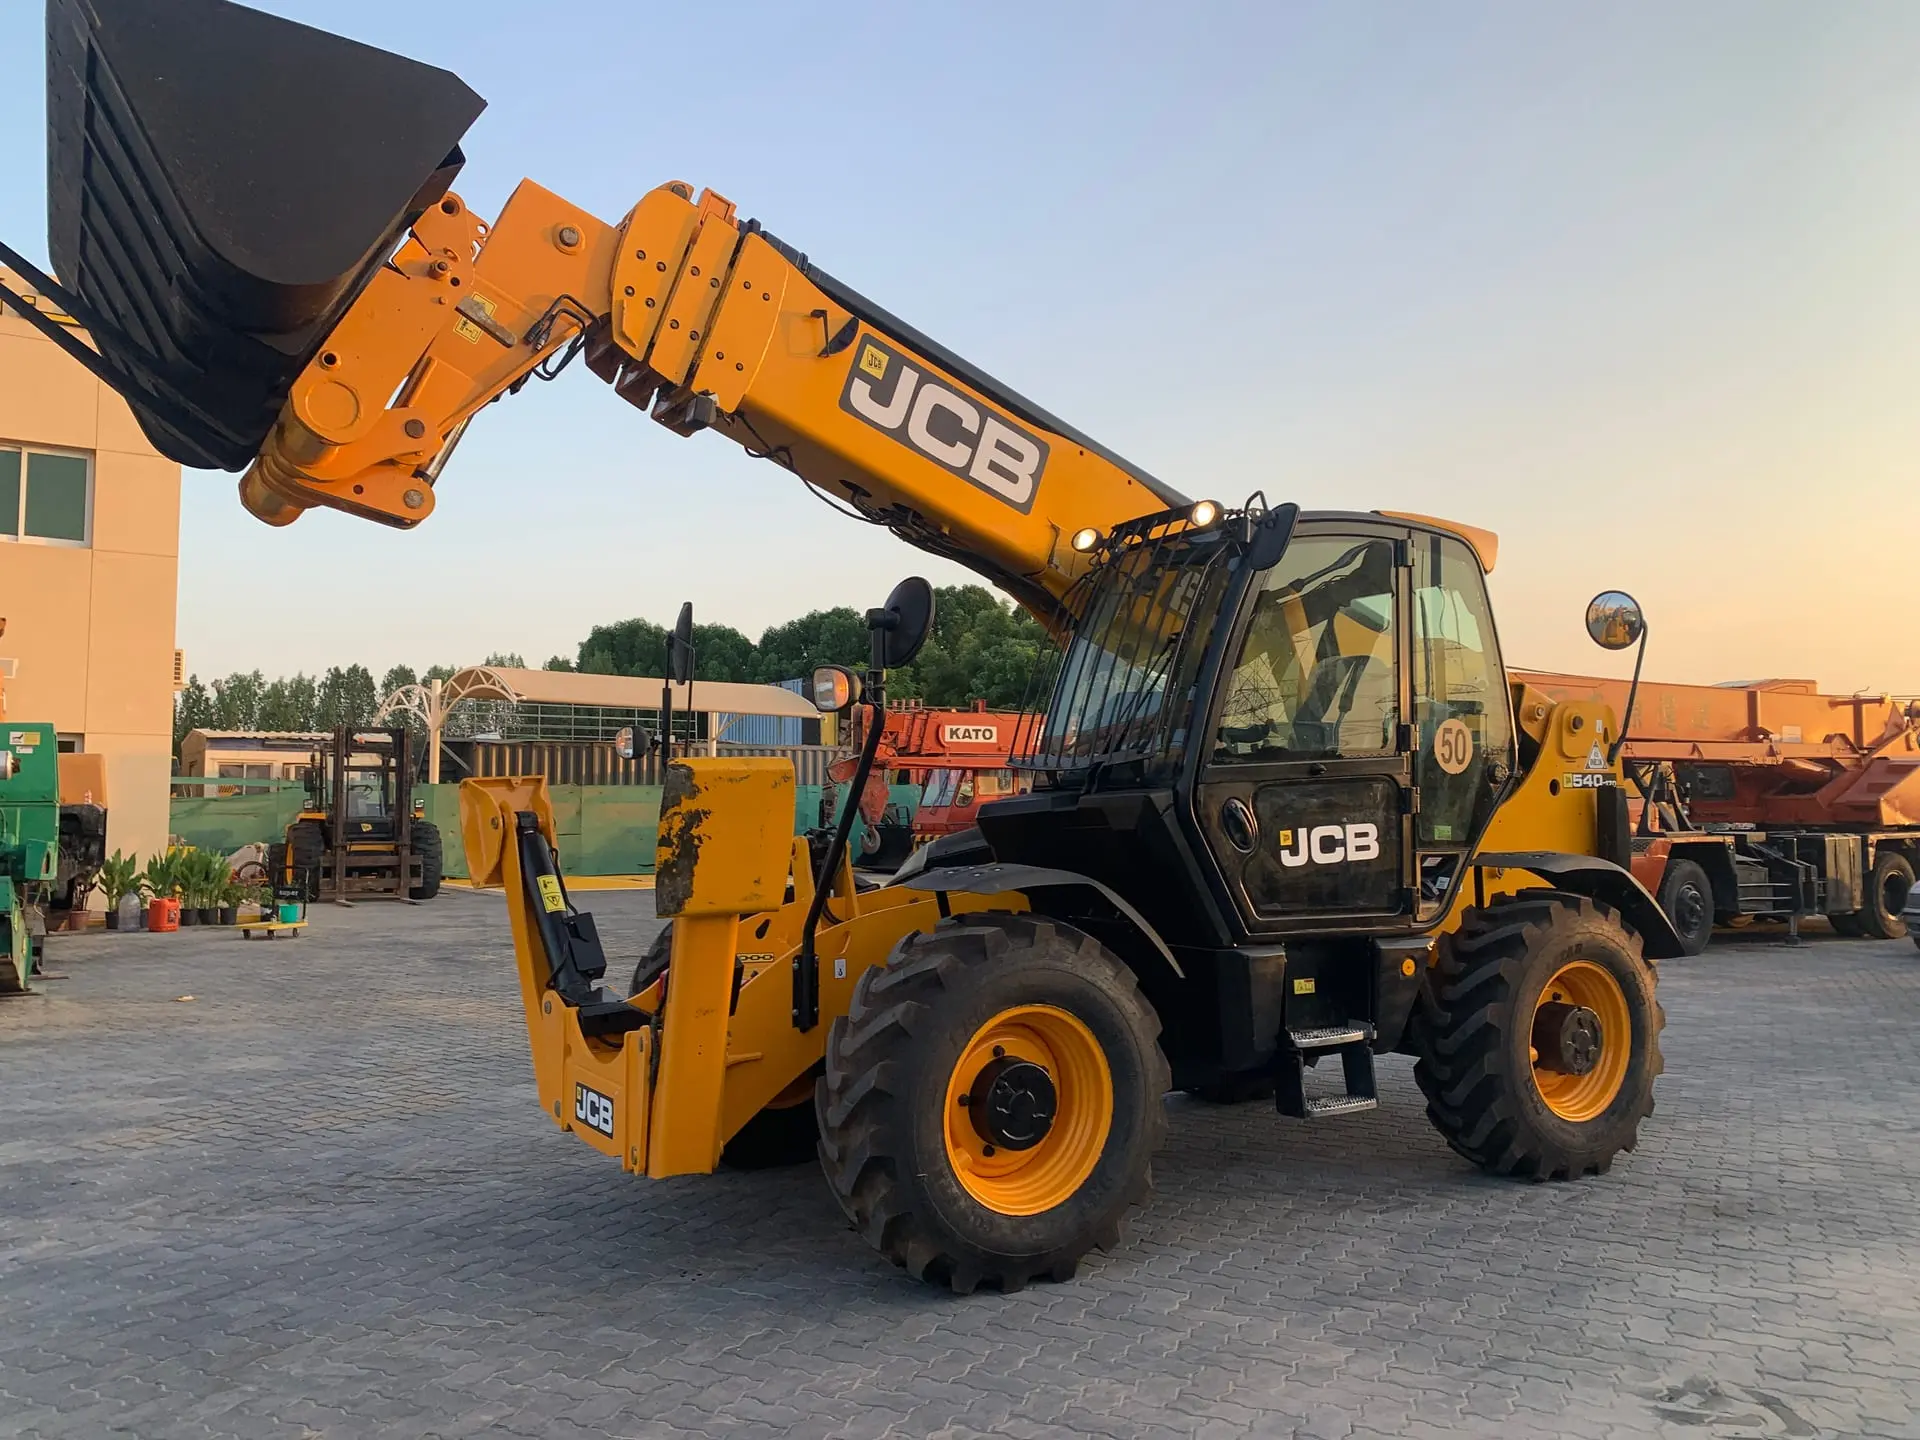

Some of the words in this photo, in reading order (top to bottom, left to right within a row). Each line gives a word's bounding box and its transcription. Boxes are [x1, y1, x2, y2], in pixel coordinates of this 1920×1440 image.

[868, 353, 882, 369] JCB
[850, 365, 1040, 504] JCB
[949, 728, 993, 740] KATO
[1441, 728, 1467, 765] 50
[1280, 823, 1380, 867] JCB
[576, 1088, 613, 1134] JCB
